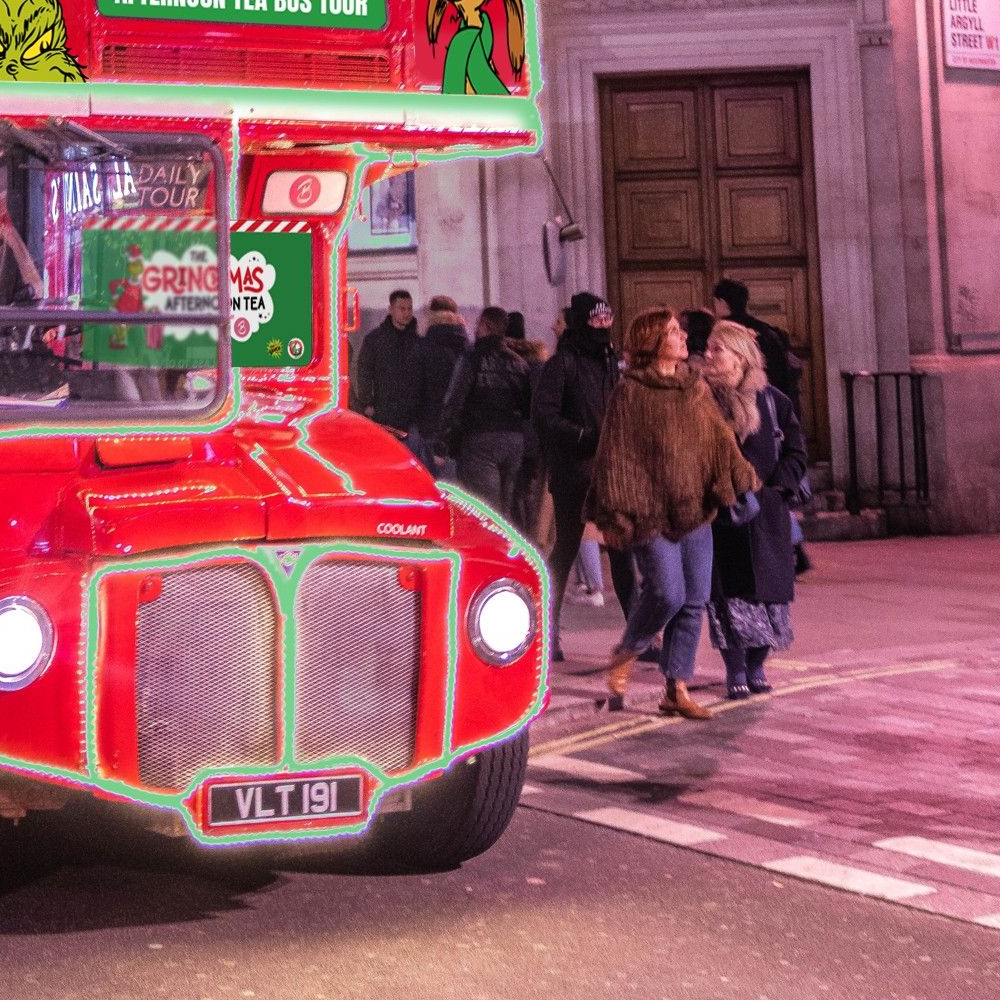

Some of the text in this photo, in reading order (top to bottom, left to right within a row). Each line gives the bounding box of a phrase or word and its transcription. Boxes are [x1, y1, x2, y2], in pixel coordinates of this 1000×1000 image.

[950, 14, 984, 32] ARGYLL
[951, 32, 1000, 51] STREET W1
[136, 160, 201, 185] DAILY
[137, 187, 200, 208] TOUR
[190, 250, 208, 263] THE
[244, 296, 266, 311] TEA
[376, 522, 428, 536] COOLANT
[235, 781, 338, 819] VLT 191
